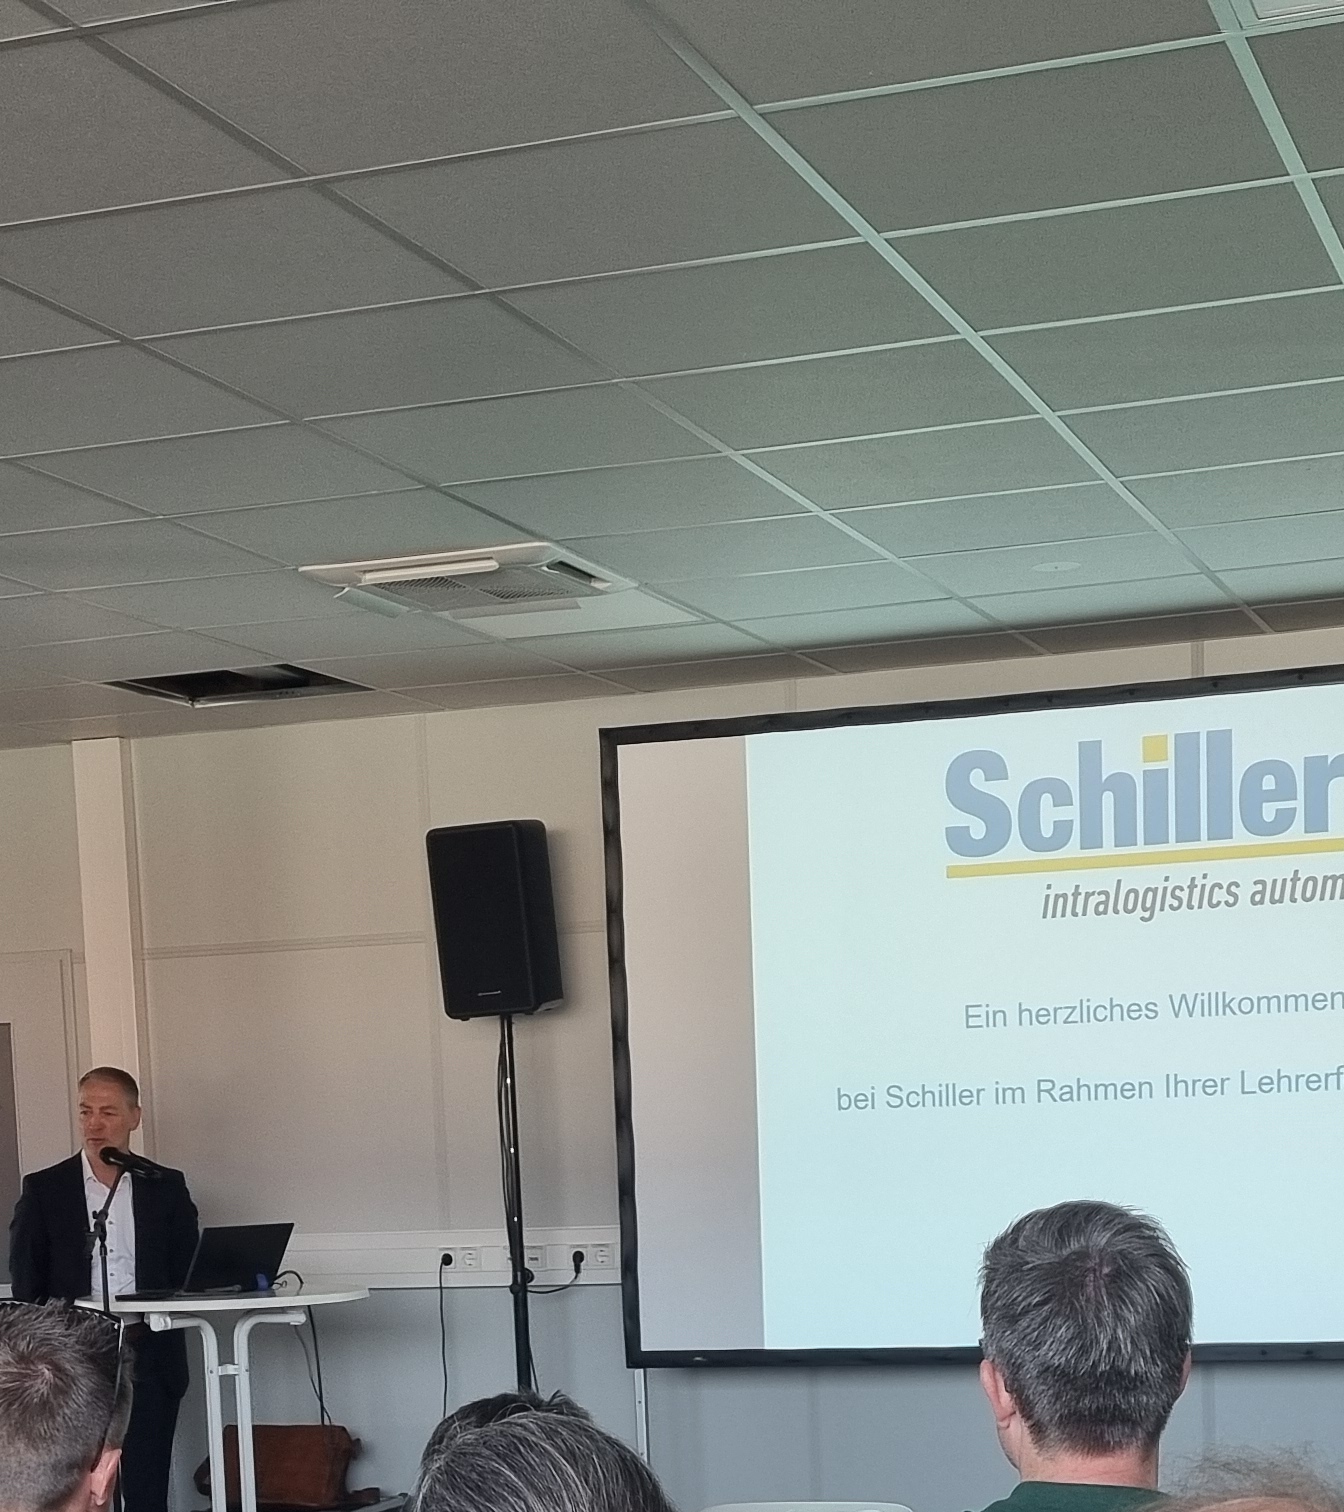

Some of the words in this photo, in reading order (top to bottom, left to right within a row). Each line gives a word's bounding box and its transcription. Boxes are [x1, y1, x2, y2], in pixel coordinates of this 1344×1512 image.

[1041, 872, 1241, 923] intralogistics
[964, 1003, 1008, 1030] Ein
[1018, 997, 1159, 1027] herzliches
[836, 1084, 876, 1112] bei
[885, 1082, 985, 1109] Schiller
[994, 1080, 1026, 1105] im
[1036, 1076, 1154, 1104] Rahmen
[1165, 1072, 1231, 1099] Ihrer
